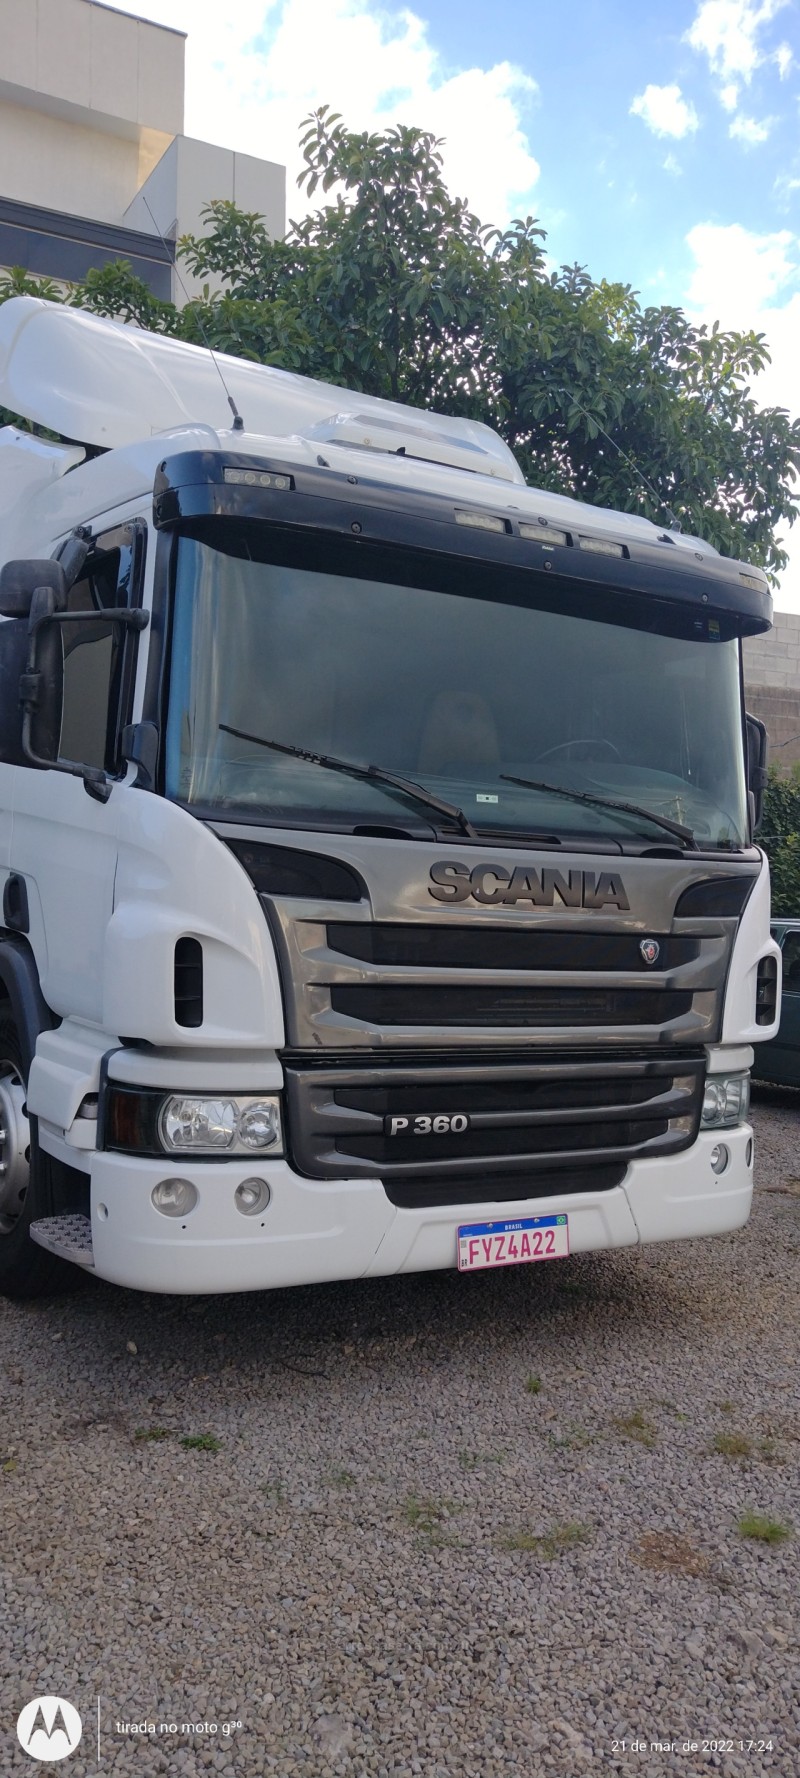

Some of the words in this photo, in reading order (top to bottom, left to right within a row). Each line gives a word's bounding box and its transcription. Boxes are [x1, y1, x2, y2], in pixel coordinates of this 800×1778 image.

[428, 860, 630, 910] SCANIA
[390, 1117, 409, 1135] P
[413, 1115, 468, 1134] 360
[504, 1223, 523, 1231] BRASIL
[469, 1230, 556, 1264] FYZ4A22
